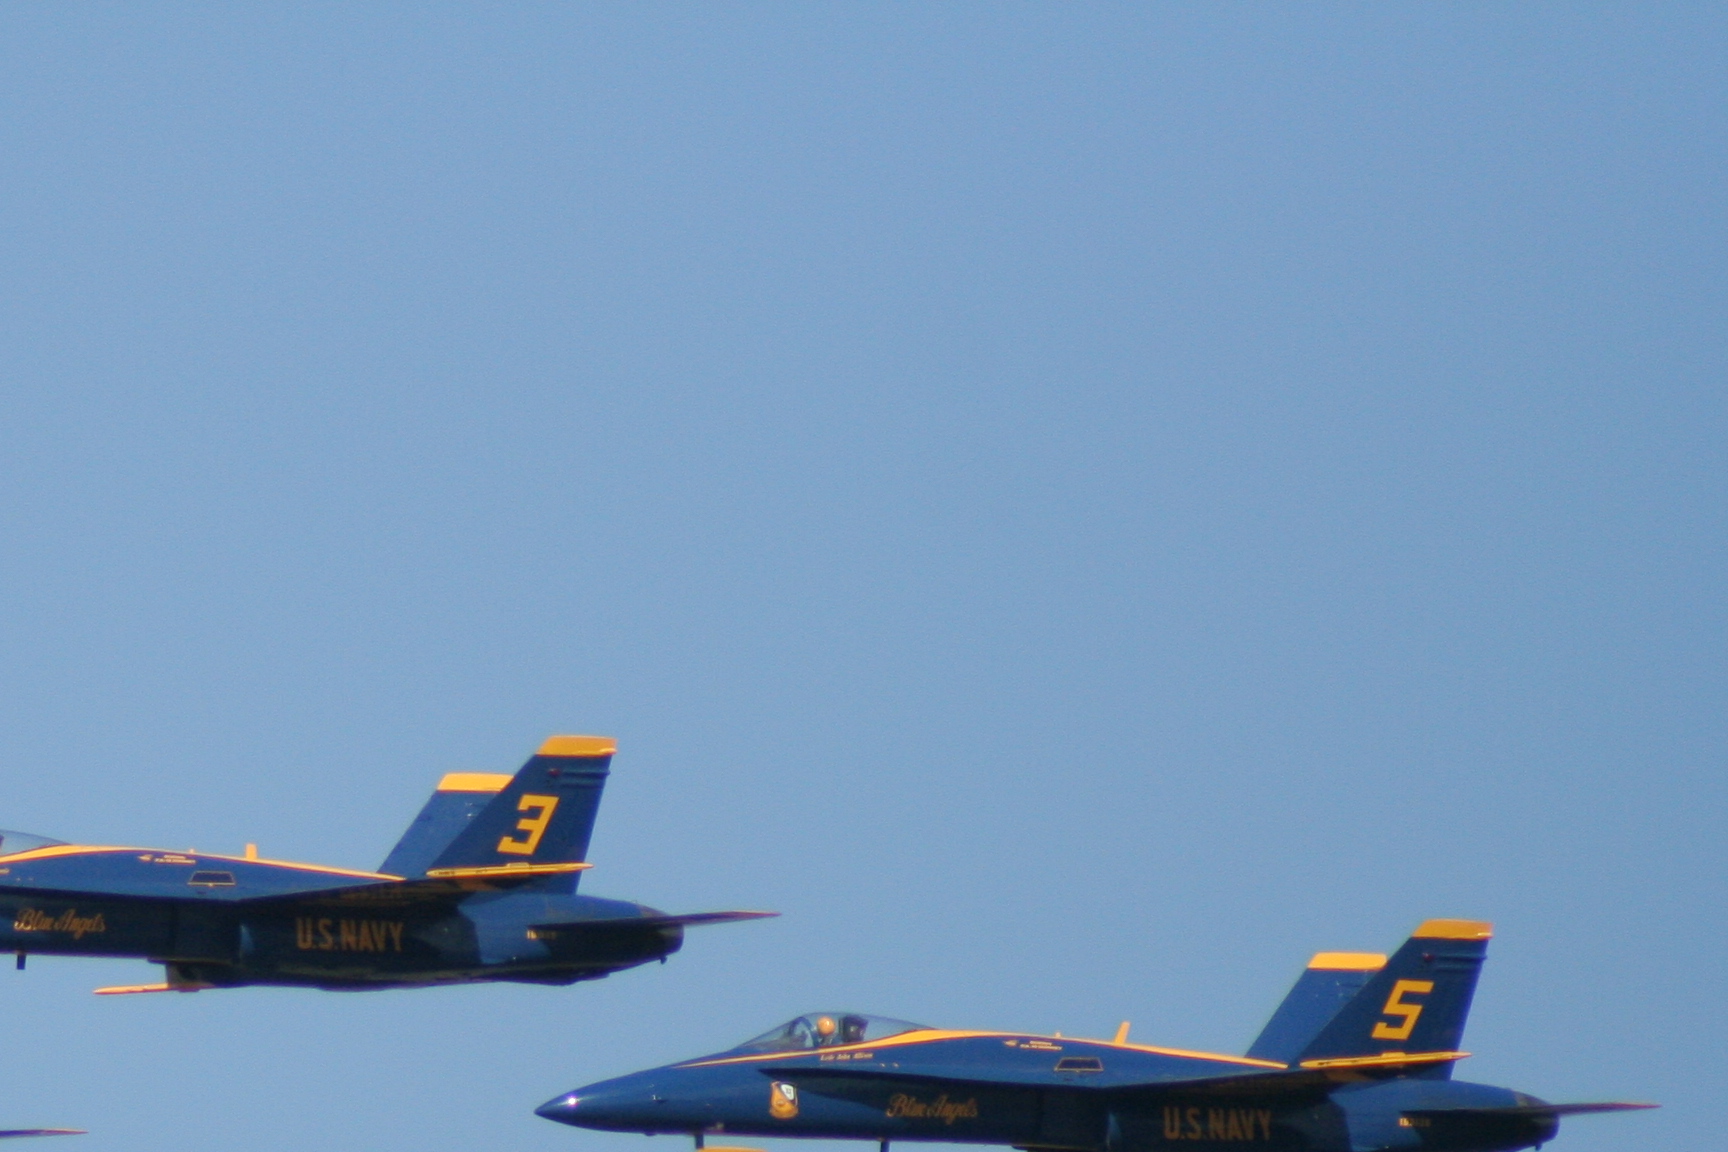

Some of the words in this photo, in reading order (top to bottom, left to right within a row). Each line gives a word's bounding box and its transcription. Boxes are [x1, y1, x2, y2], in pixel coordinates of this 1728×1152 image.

[496, 794, 560, 855] 3
[13, 907, 55, 931] Blue
[54, 908, 105, 940] Angels
[340, 918, 404, 952] NAVY
[1371, 979, 1434, 1041] 5
[886, 1094, 927, 1118] Blue
[926, 1094, 978, 1125] Angels
[1208, 1108, 1271, 1141] NAVY
